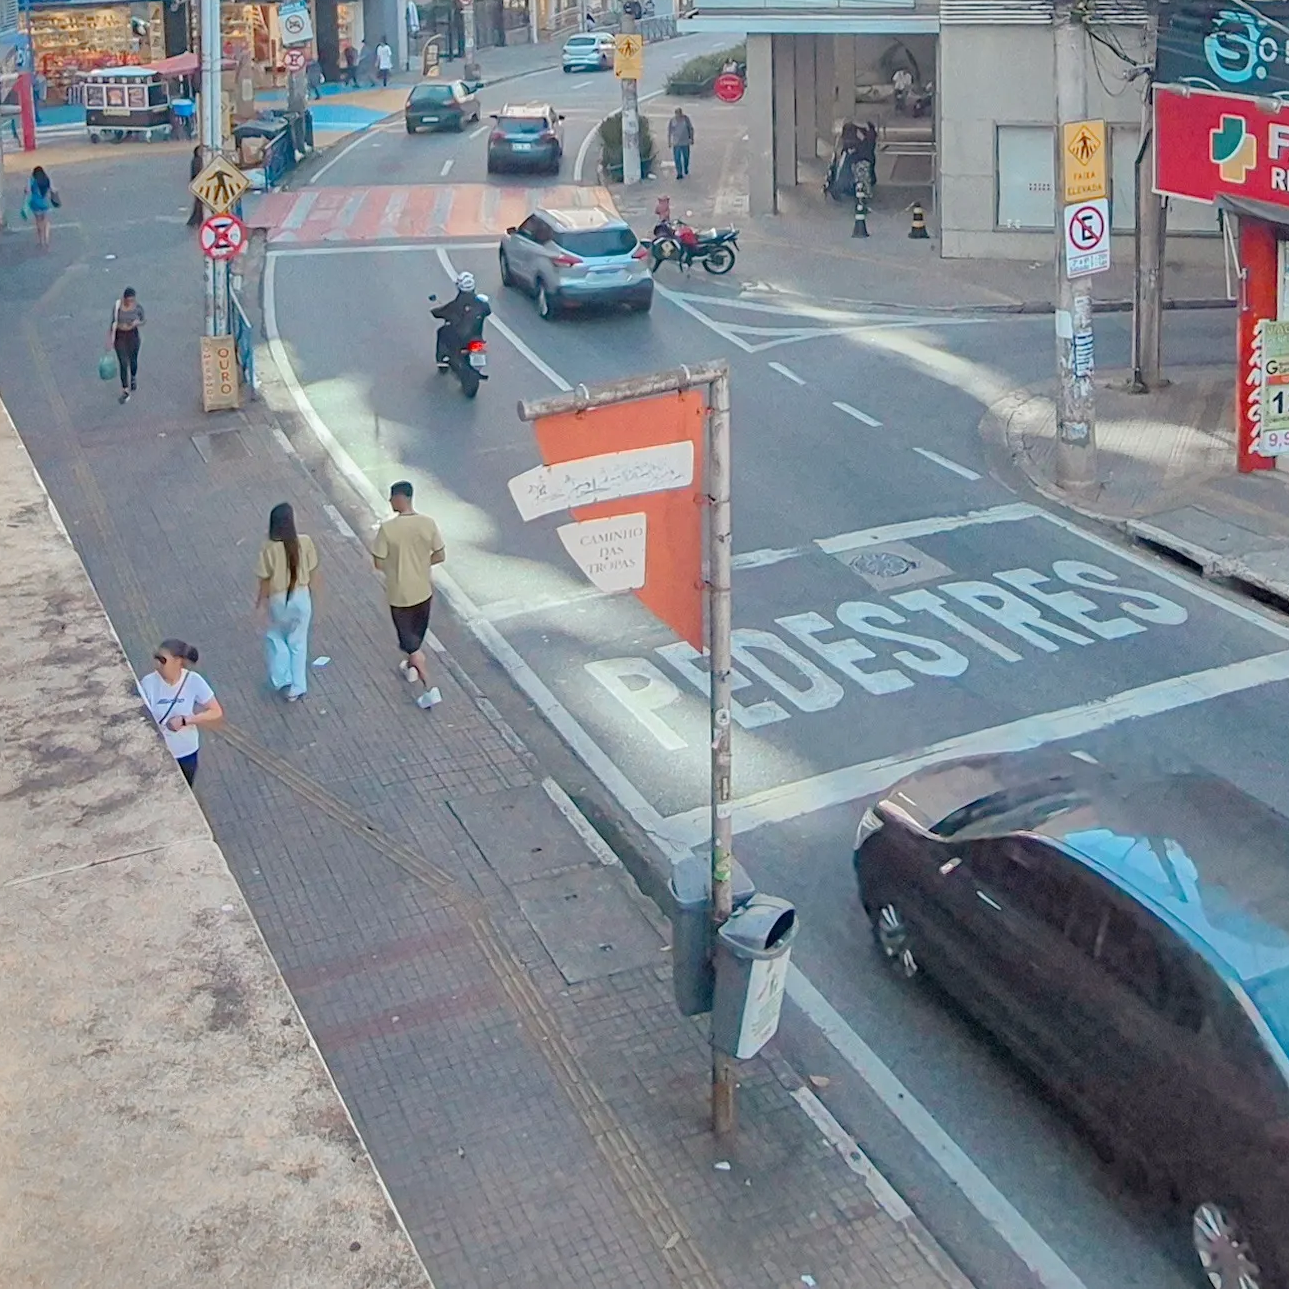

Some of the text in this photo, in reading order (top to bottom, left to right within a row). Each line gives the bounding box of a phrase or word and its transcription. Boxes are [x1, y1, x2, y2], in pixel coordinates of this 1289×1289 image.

[217, 347, 232, 395] OURO
[580, 527, 643, 546] CAMINHO
[600, 546, 624, 558] DAS
[584, 559, 1189, 751] PEDESTRES
